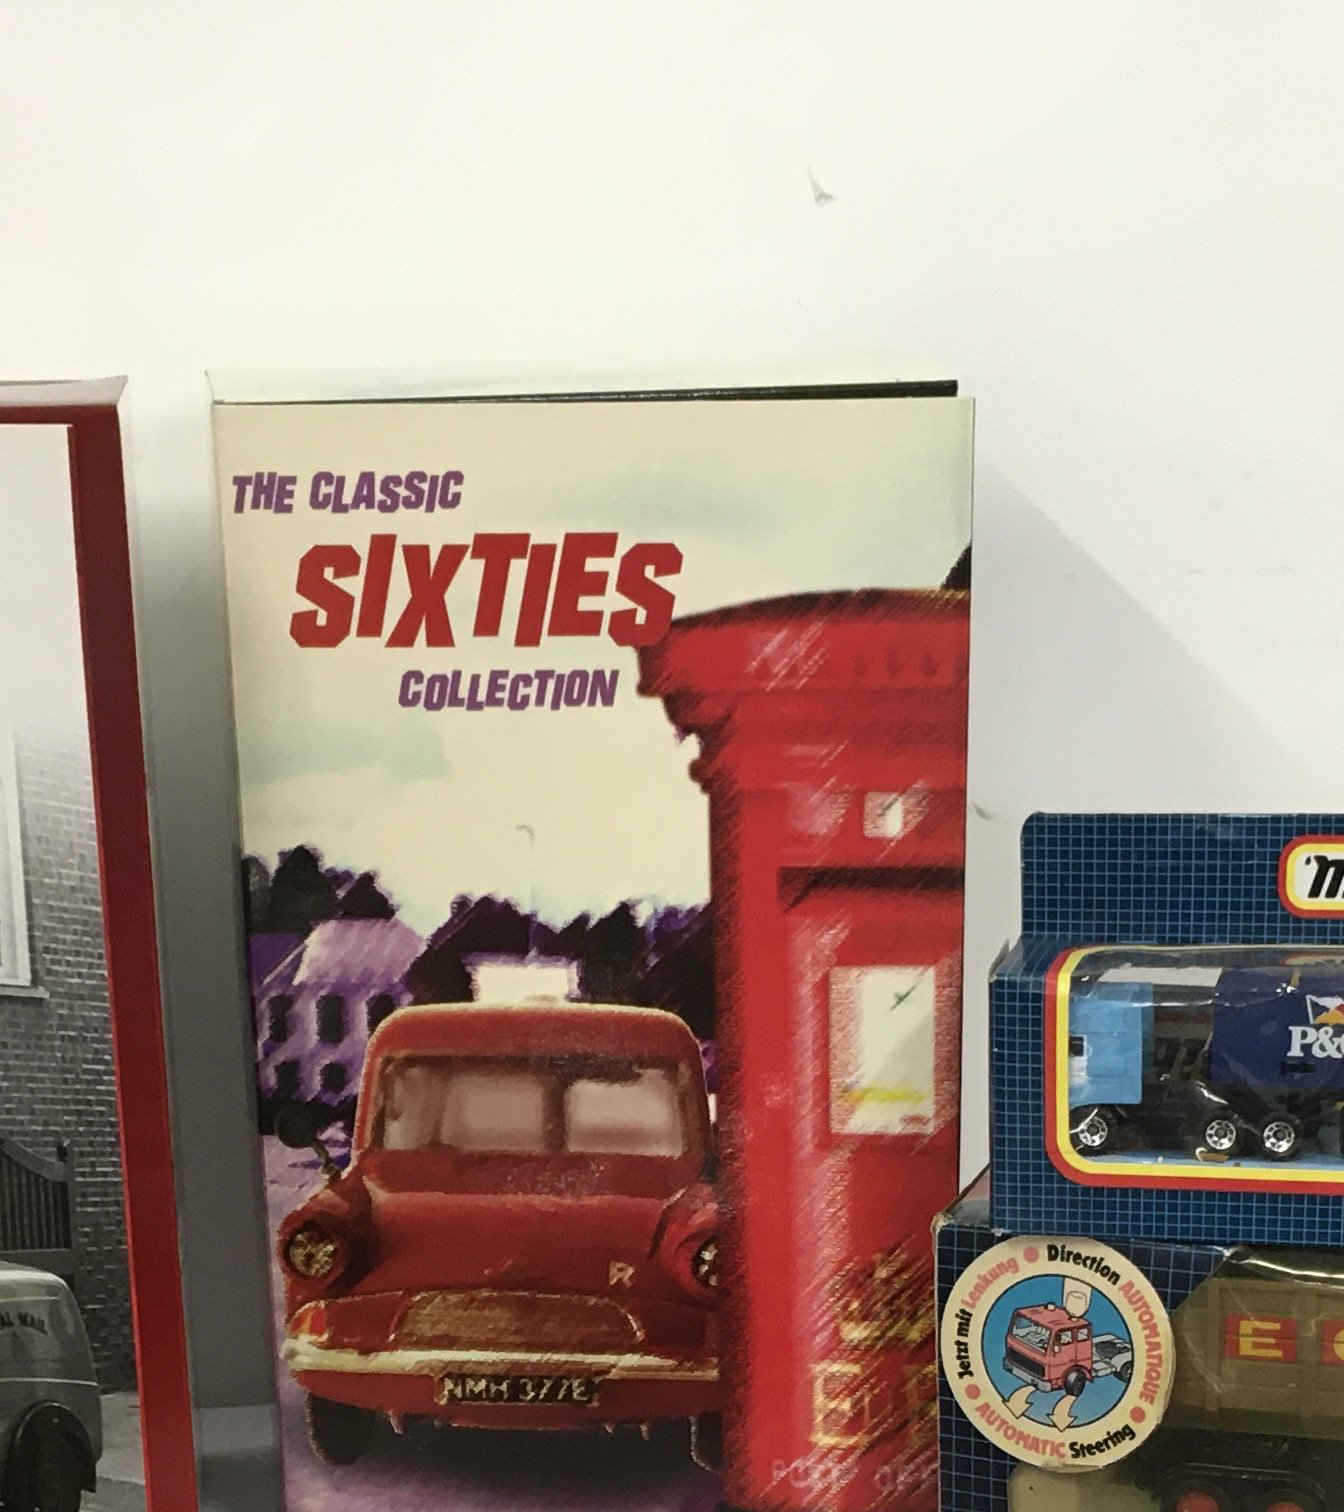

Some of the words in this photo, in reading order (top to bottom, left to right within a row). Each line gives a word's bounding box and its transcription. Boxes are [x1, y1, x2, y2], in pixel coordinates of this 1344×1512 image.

[232, 472, 296, 514] THE
[309, 470, 463, 513] CLASSIC
[290, 532, 683, 648] SIXTIES
[399, 670, 619, 711] COLLECTION
[961, 1257, 1020, 1309] Lenkung
[16, 1311, 48, 1336] MAIL
[955, 1308, 973, 1338] mit
[1047, 1244, 1121, 1286] Direction
[1119, 1280, 1163, 1405] AUTOMATIQUE
[954, 1340, 974, 1379] Jetzt
[975, 1402, 1066, 1458] AUTOMATIC
[1069, 1424, 1136, 1459] Steering
